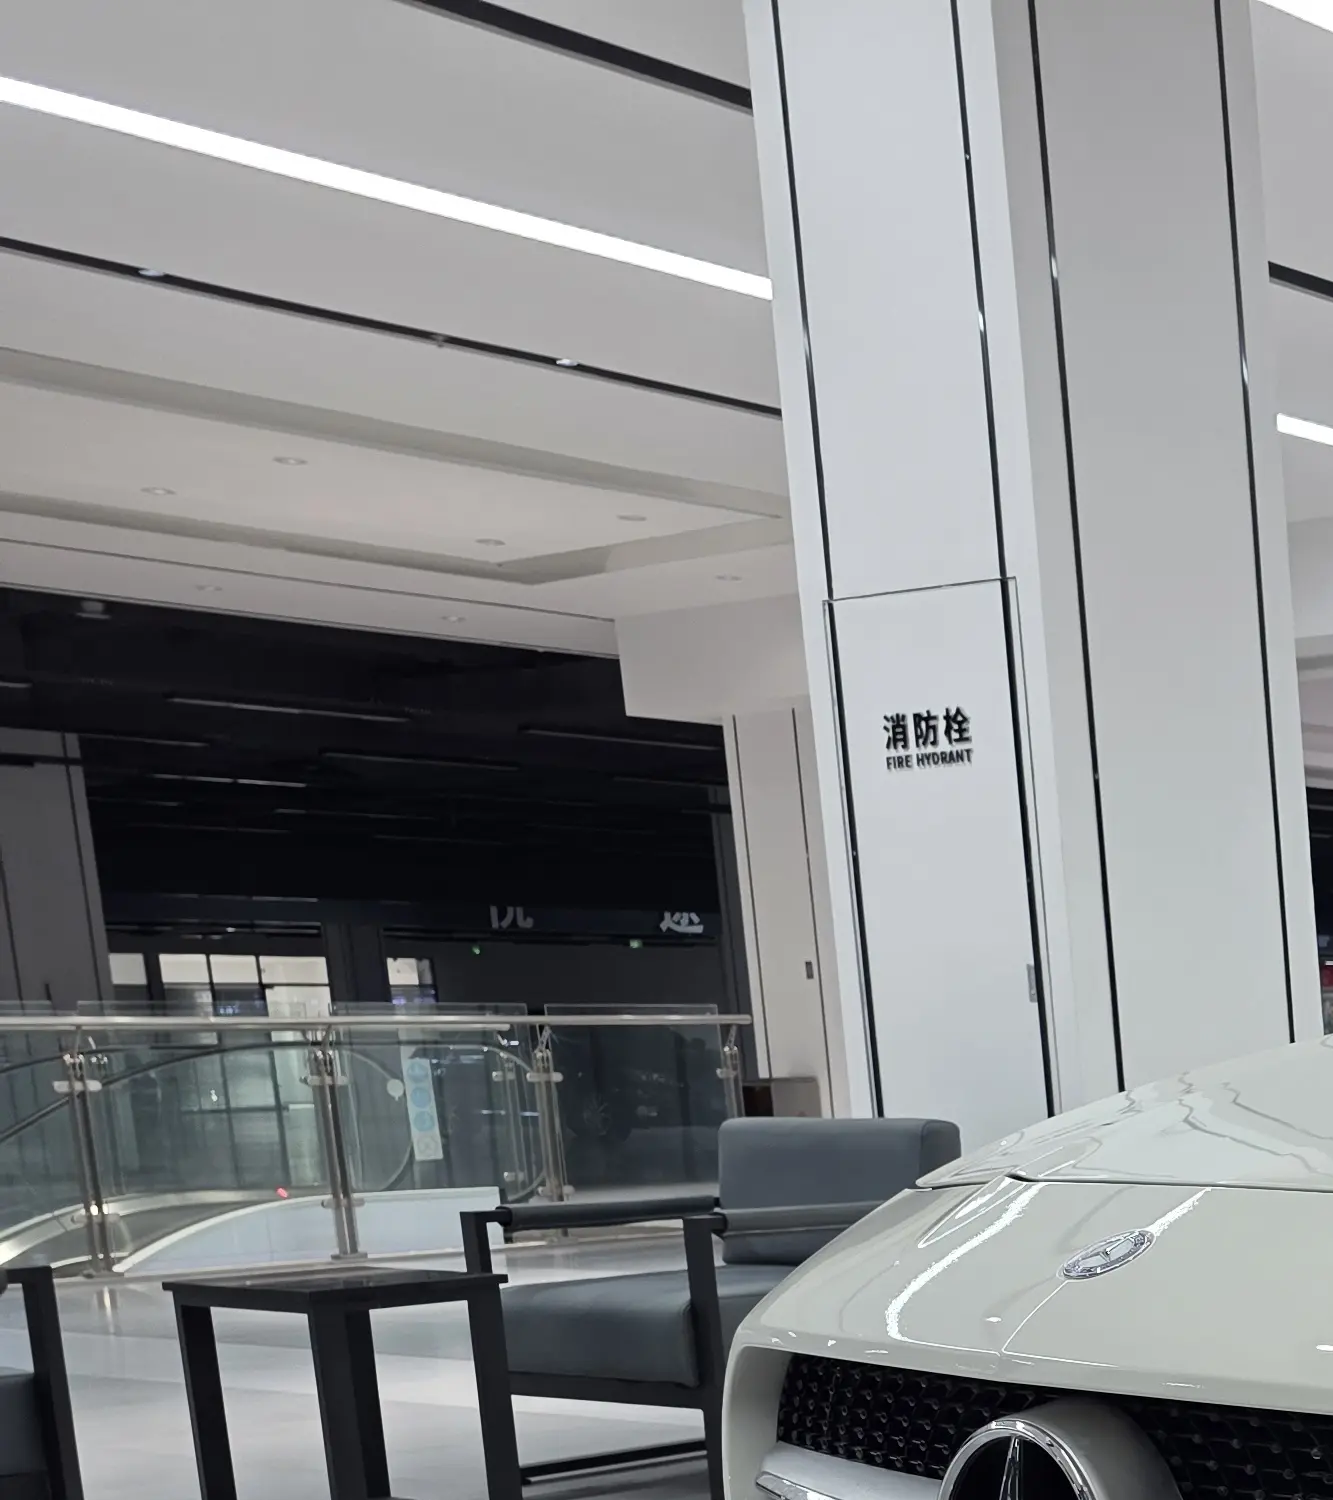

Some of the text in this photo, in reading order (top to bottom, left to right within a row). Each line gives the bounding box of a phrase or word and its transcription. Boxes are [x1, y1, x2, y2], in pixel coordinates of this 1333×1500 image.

[883, 706, 972, 750] 消防栓
[886, 748, 973, 770] FIRE HYDRANT
